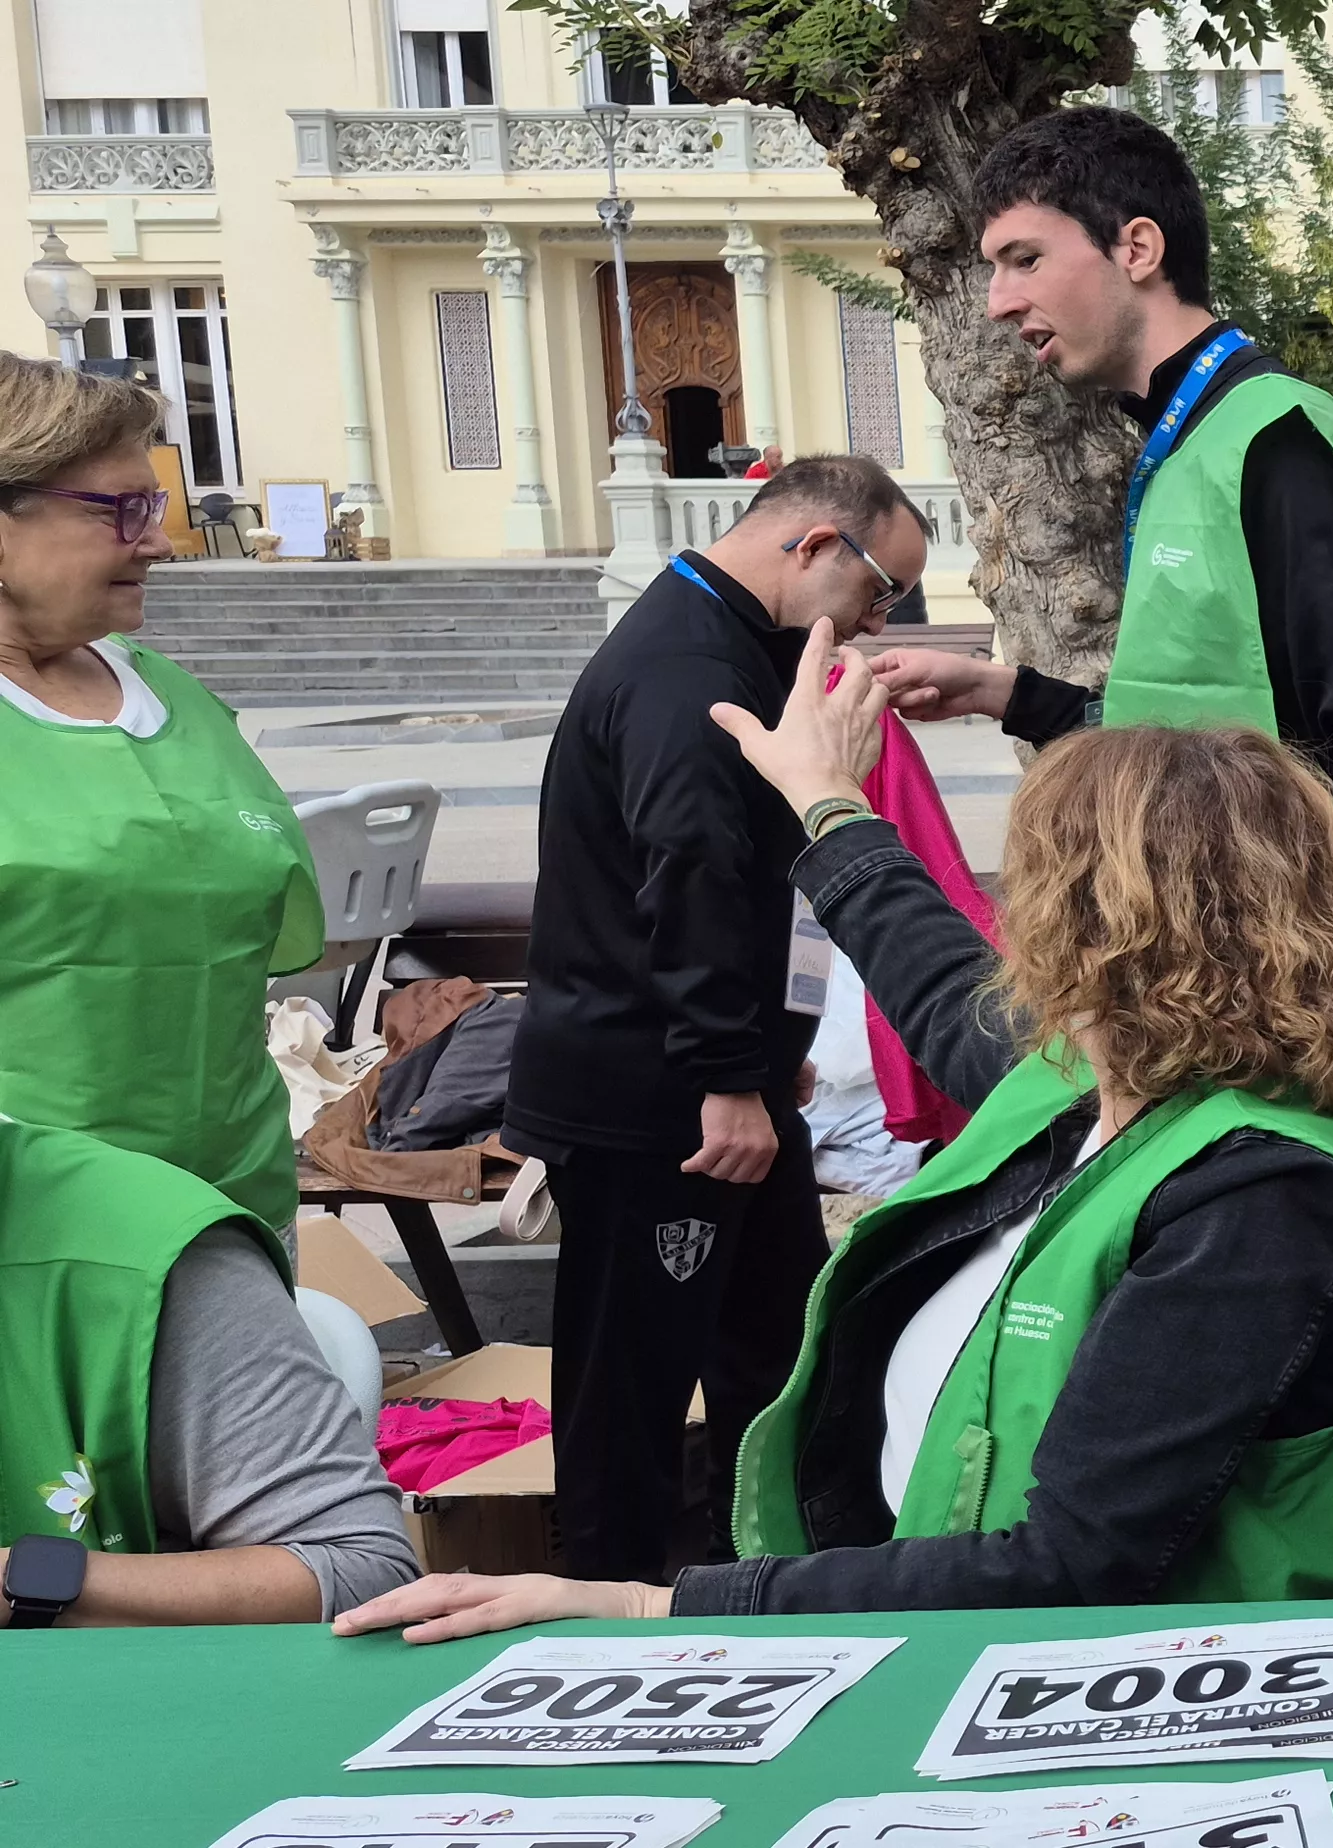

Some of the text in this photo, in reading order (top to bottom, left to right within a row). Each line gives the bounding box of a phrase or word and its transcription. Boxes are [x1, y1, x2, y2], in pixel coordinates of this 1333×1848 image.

[455, 1673, 818, 1720] 2506
[983, 1698, 1322, 1741] CONTRA EL CÁNCER
[429, 1726, 748, 1743] CONTRA EL CÁNCER
[1098, 1723, 1201, 1742] HUESCA
[524, 1740, 622, 1751] HUESCA
